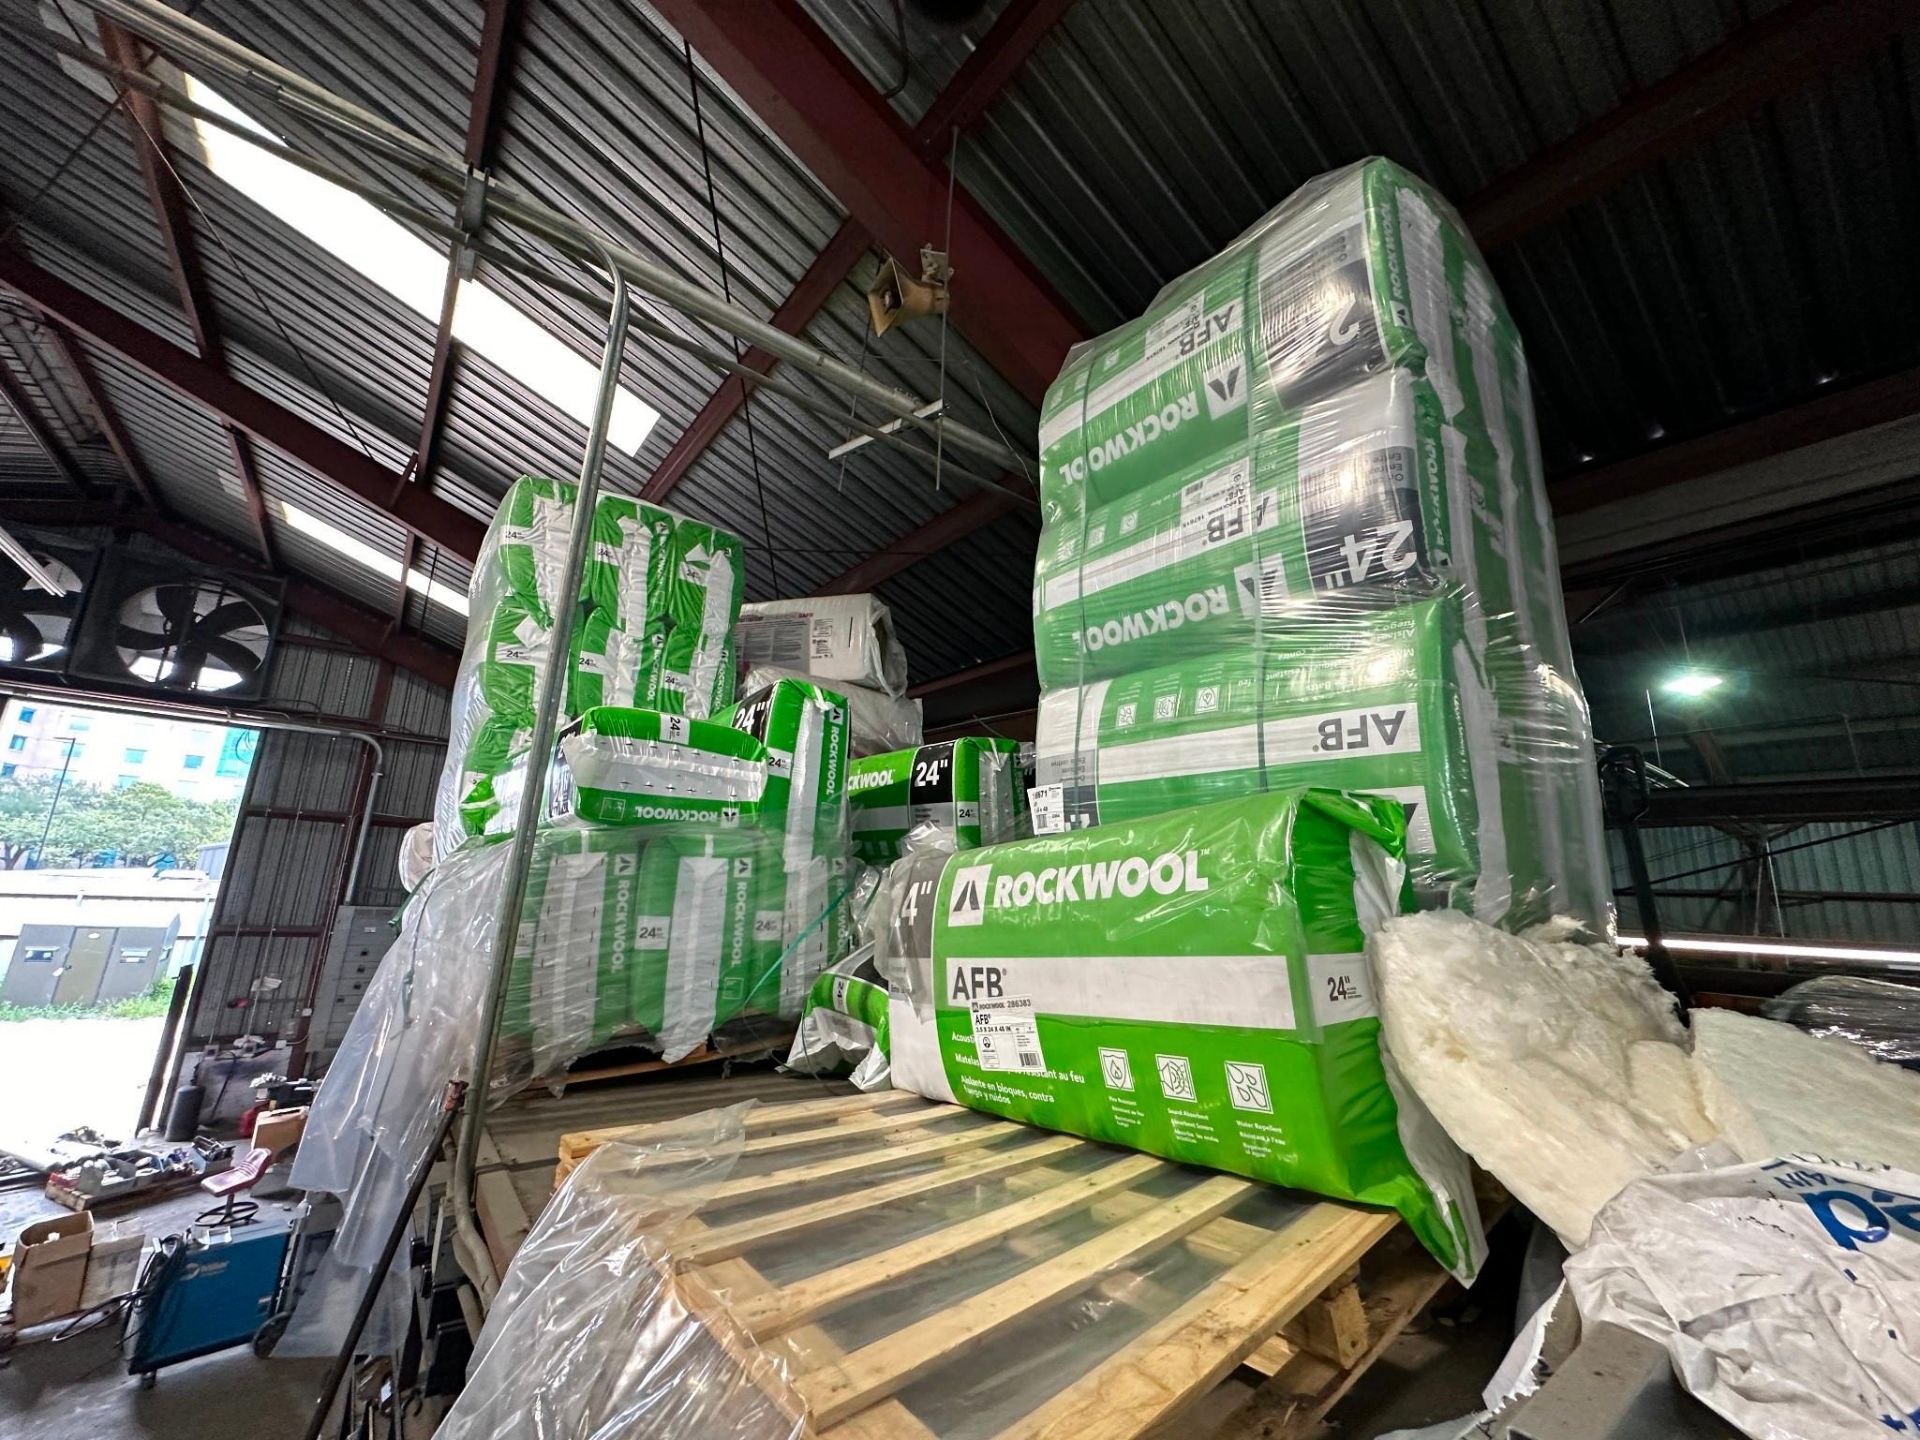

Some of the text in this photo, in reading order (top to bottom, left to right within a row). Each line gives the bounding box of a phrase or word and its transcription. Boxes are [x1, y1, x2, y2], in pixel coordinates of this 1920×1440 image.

[1059, 391, 1199, 486] ROCKWOOL
[647, 649, 662, 701] ROCKWOOL
[826, 727, 839, 795] ROCKWOOL
[915, 759, 948, 787] 24"
[635, 805, 718, 822] ROCKWOOL
[611, 880, 630, 973] ROCKWOOL
[731, 881, 747, 967] ROCKWOOL
[1327, 975, 1350, 1002] 24"
[987, 1083, 996, 1091] en
[1029, 1091, 1054, 1103] contra
[1058, 1073, 1068, 1081] au
[1070, 1070, 1085, 1084] feu
